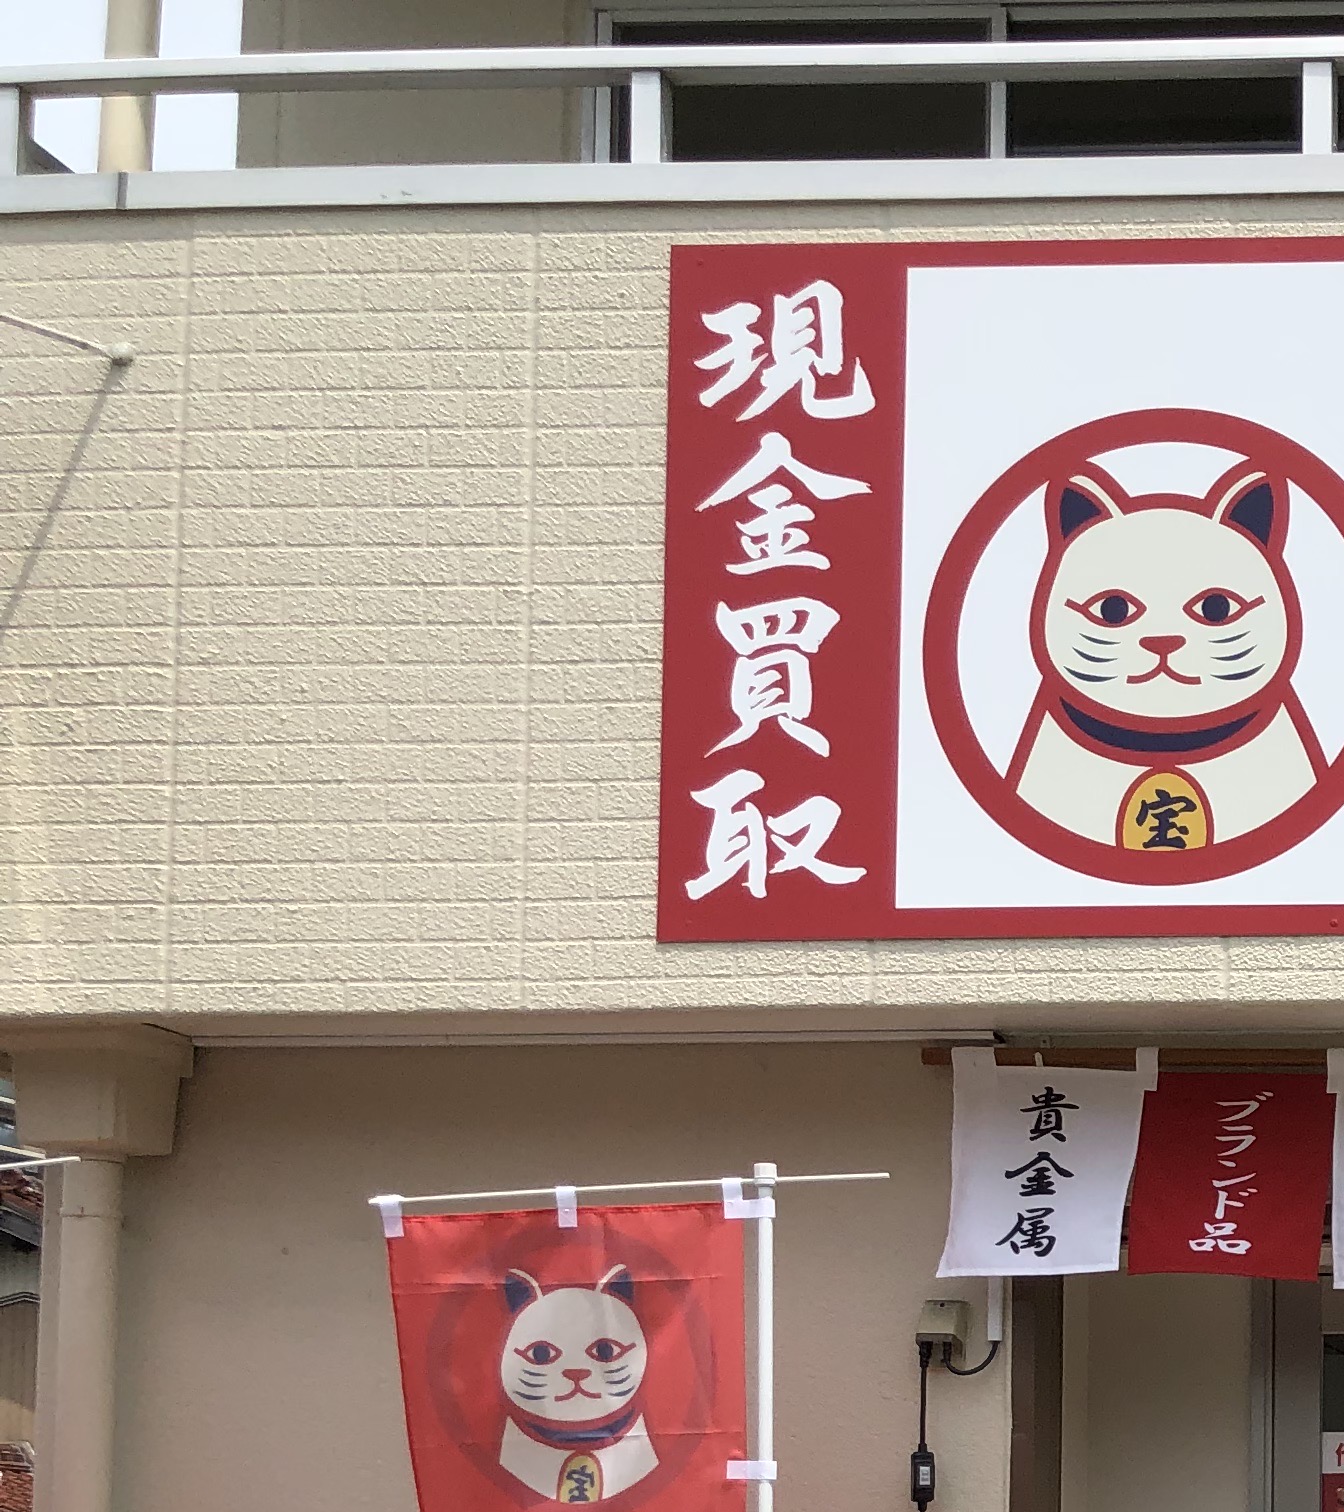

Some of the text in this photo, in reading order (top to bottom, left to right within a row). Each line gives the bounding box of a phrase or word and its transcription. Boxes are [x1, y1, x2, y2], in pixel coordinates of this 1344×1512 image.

[684, 279, 876, 900] 現金買取
[1134, 788, 1200, 851] 宝
[995, 1086, 1080, 1257] 貴金属
[1189, 1090, 1273, 1256] ブランド品
